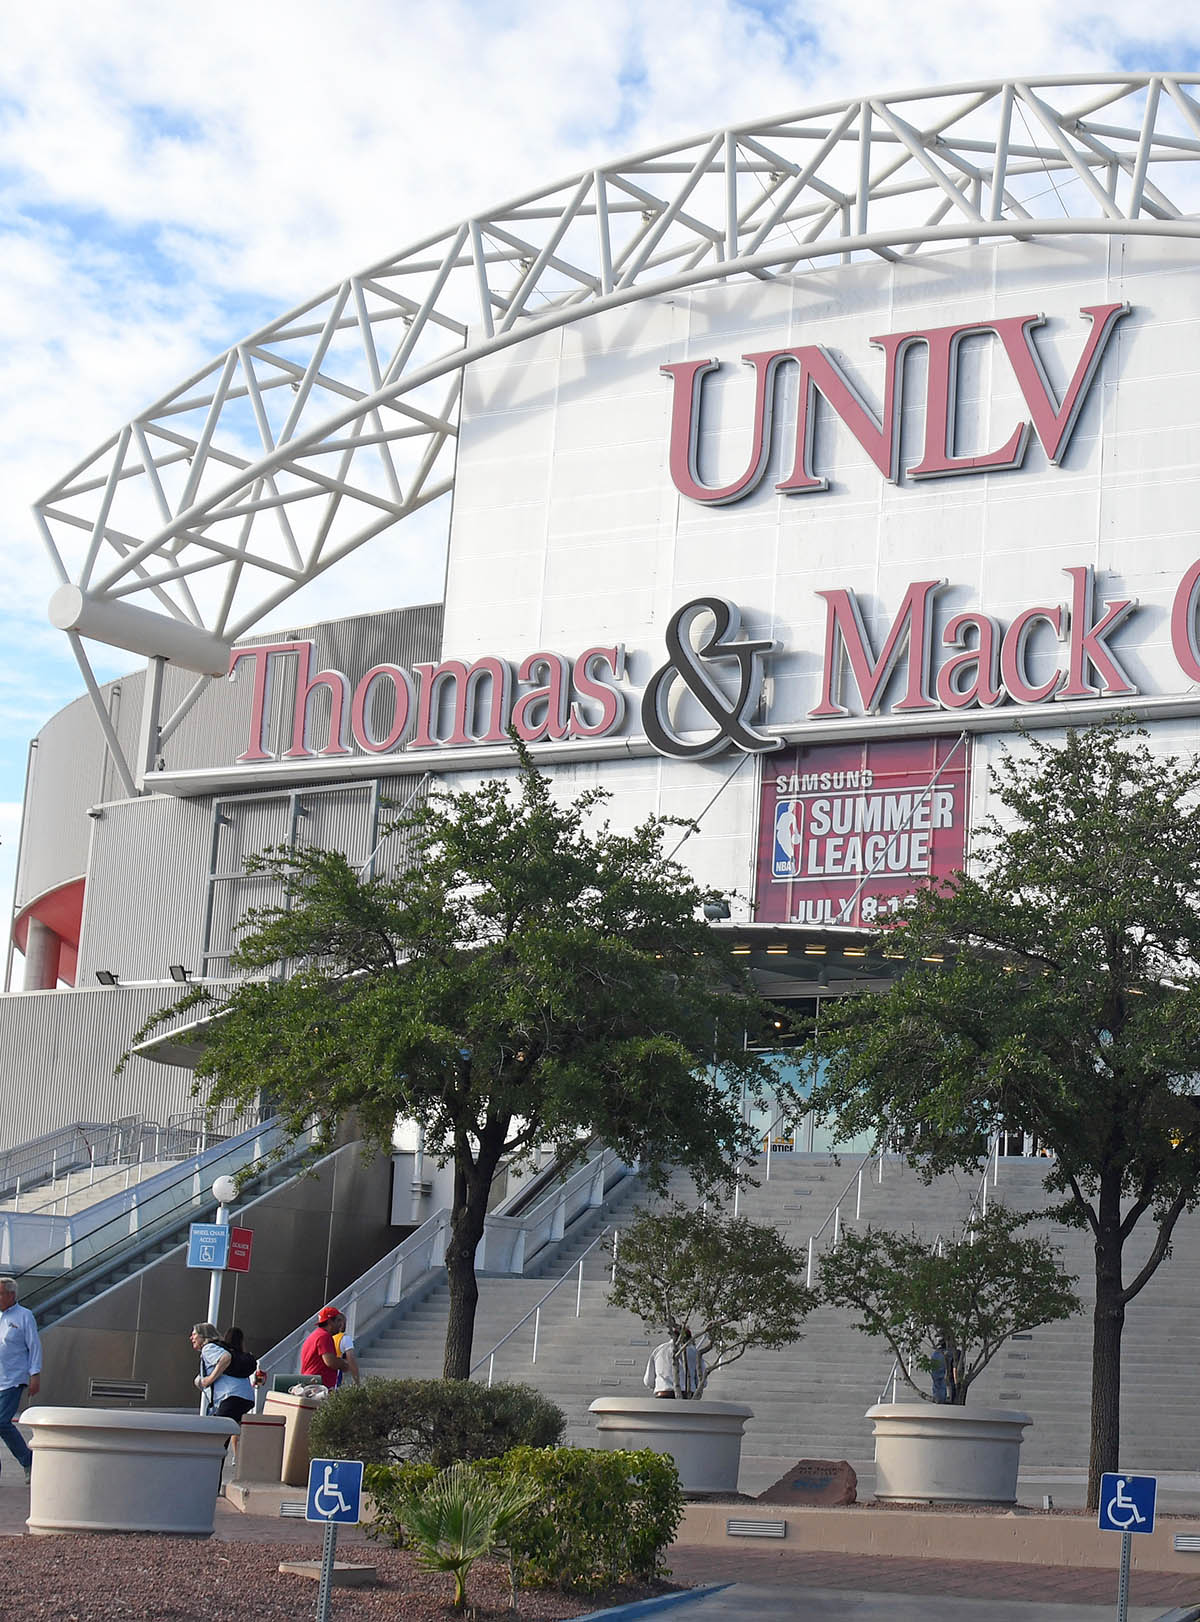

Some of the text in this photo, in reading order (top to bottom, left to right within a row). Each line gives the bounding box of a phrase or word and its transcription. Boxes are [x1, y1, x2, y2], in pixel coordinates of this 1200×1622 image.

[660, 300, 1131, 507] UNLV
[228, 639, 626, 763] Thomas
[641, 595, 786, 760] &
[806, 565, 1139, 720] Mack
[776, 769, 873, 793] SAMSUNG
[810, 792, 954, 836] SUMMER
[775, 861, 791, 872] NBA
[807, 832, 930, 874] LEAGUE
[791, 898, 858, 924] JULY
